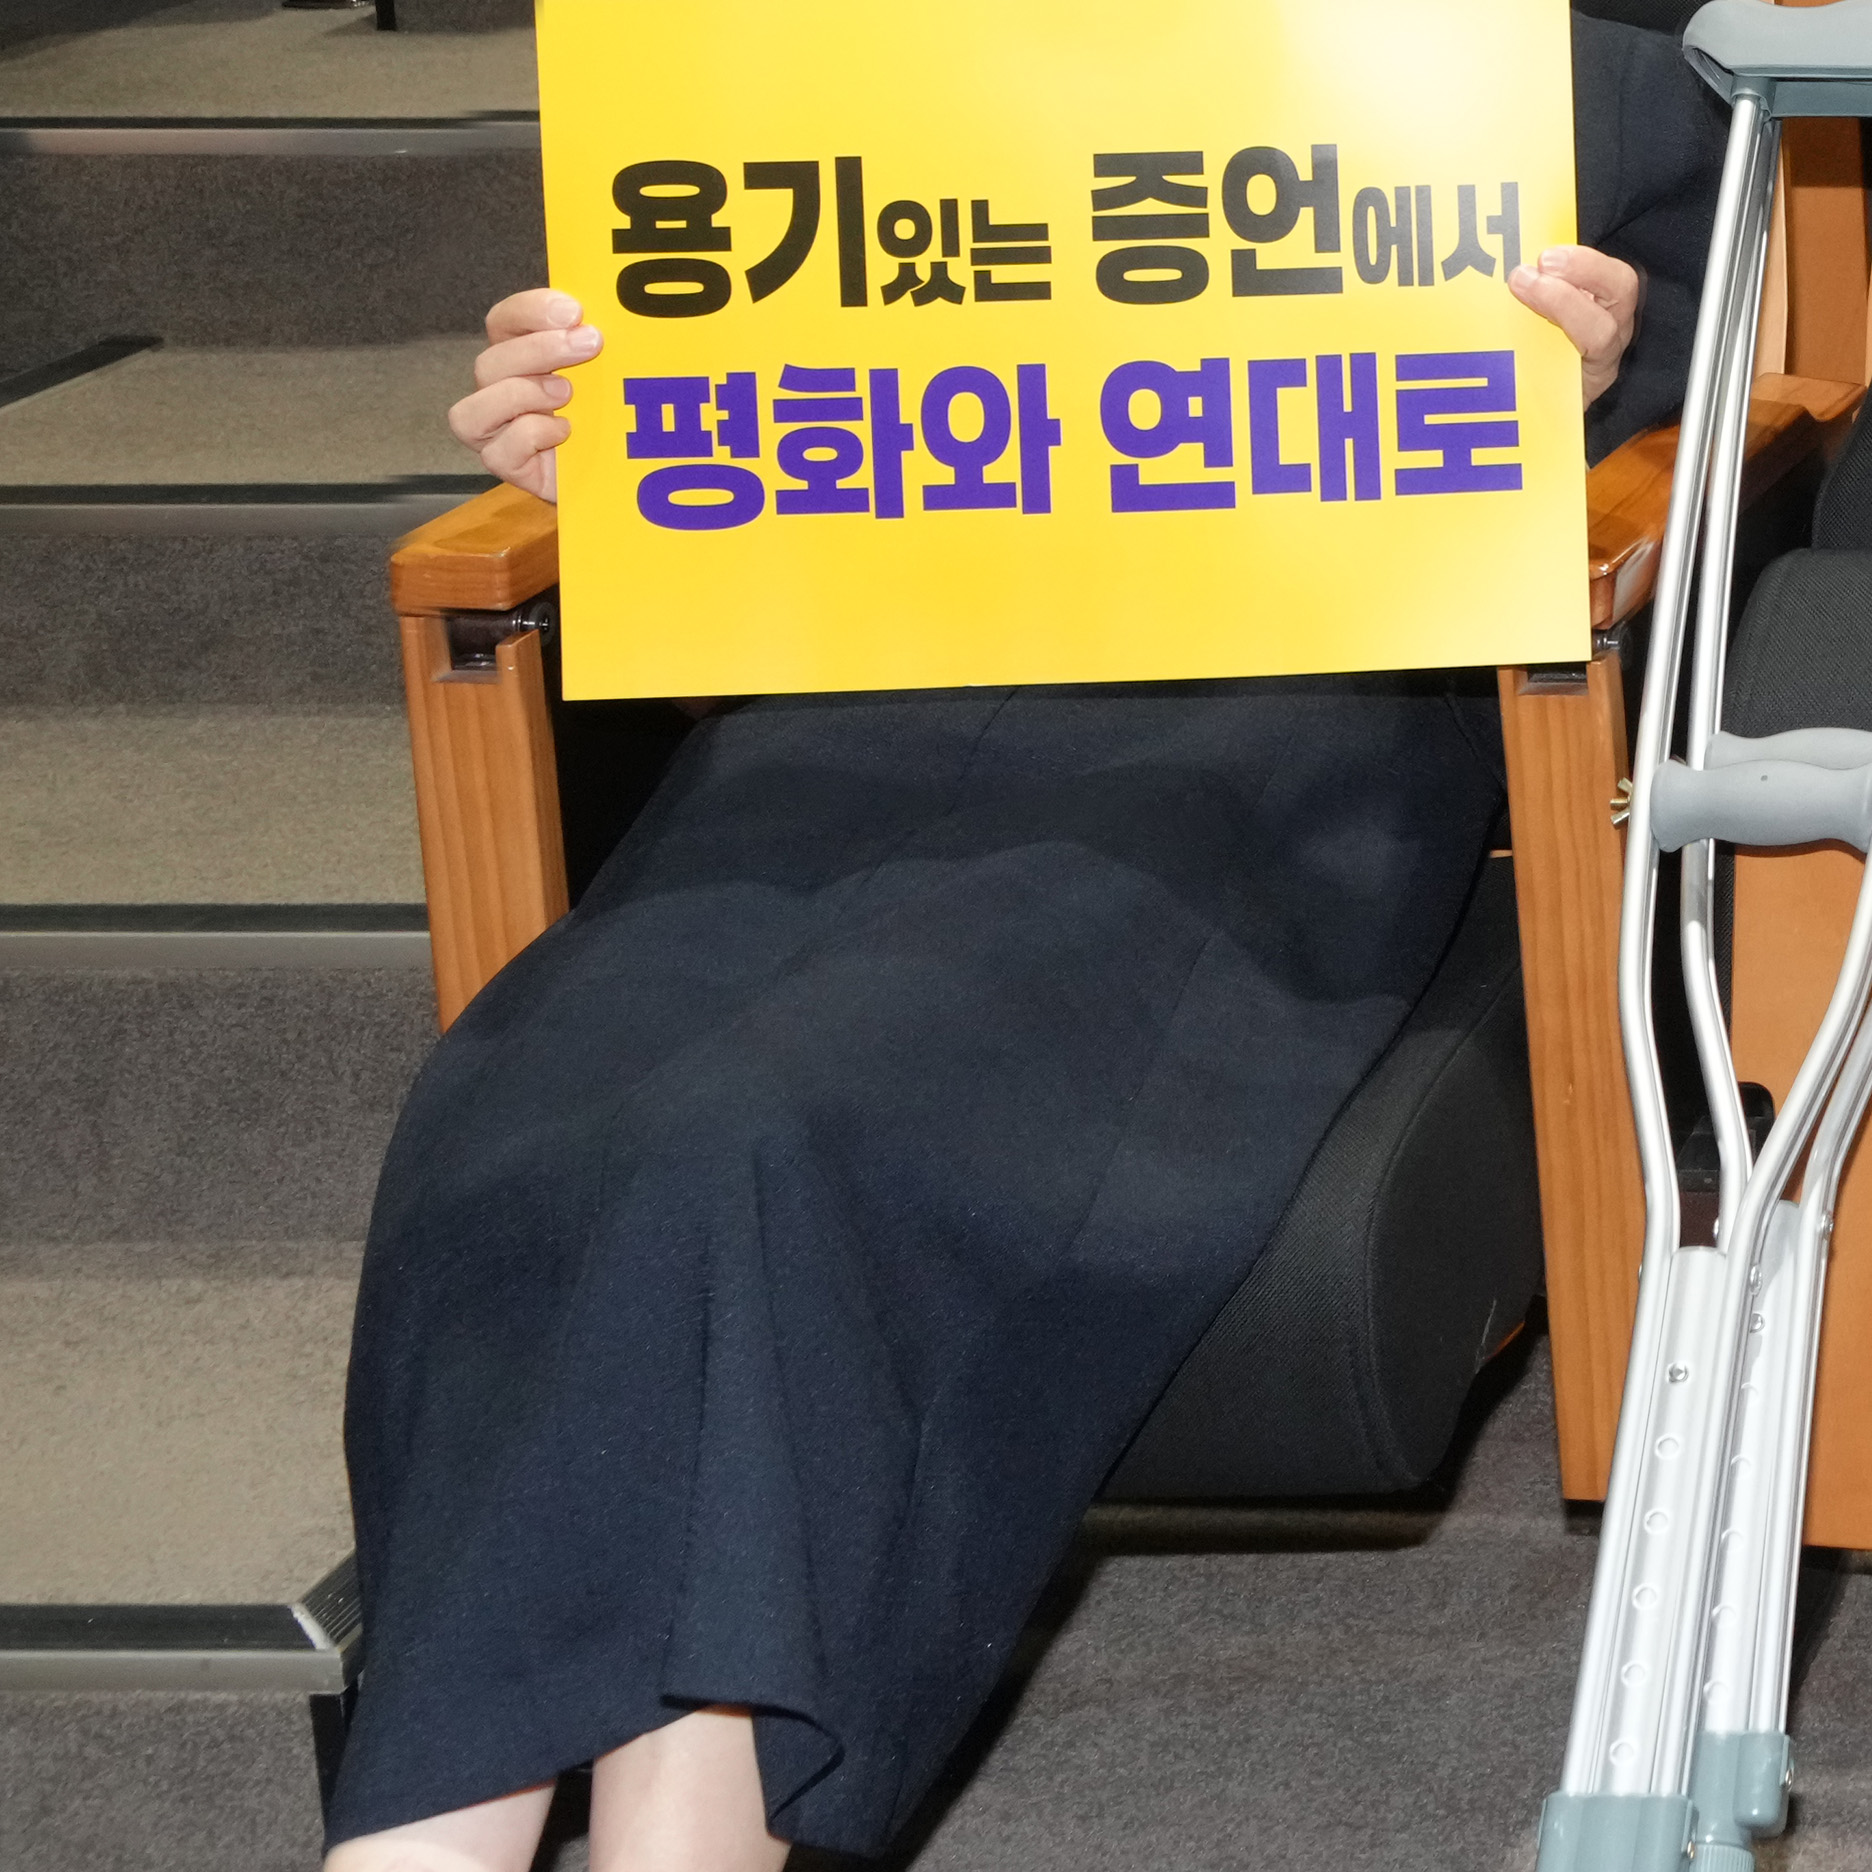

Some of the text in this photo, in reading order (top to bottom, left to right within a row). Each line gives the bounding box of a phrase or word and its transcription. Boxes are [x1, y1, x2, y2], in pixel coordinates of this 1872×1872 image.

[611, 143, 1521, 318] 용기있는 증언에서
[624, 350, 1524, 530] 평화와 연대로
